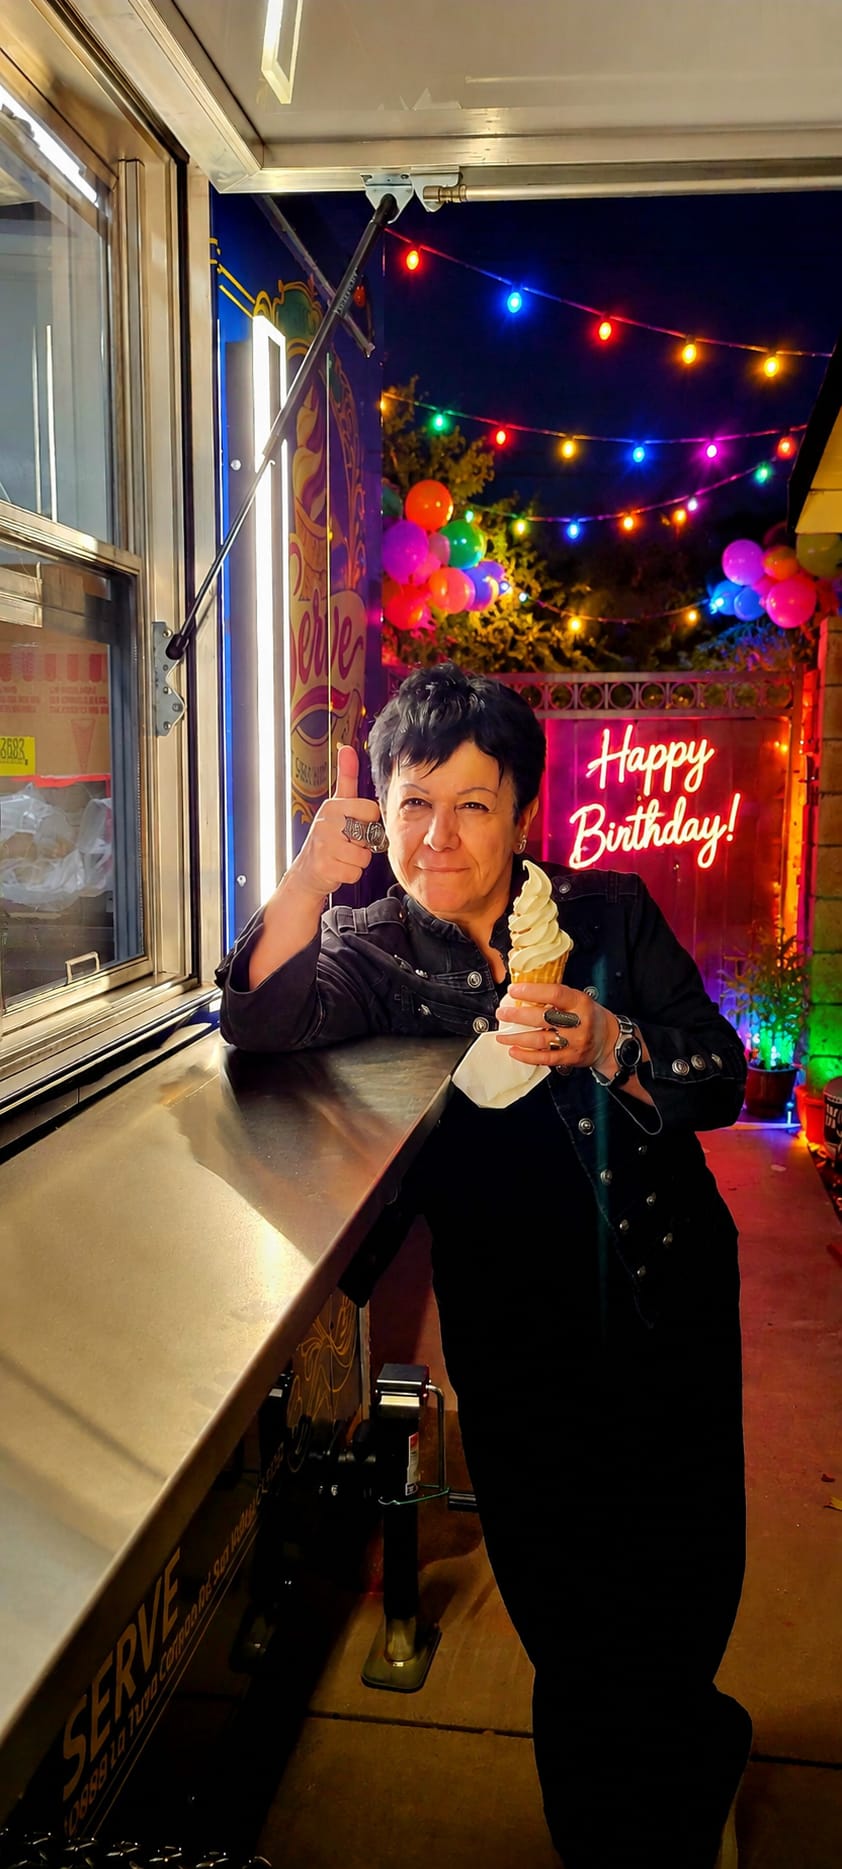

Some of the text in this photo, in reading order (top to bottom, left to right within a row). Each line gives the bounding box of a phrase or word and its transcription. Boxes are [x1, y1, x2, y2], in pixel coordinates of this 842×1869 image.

[585, 724, 715, 796] Happy
[569, 793, 741, 869] Birthday!
[63, 1547, 181, 1801] SERVE
